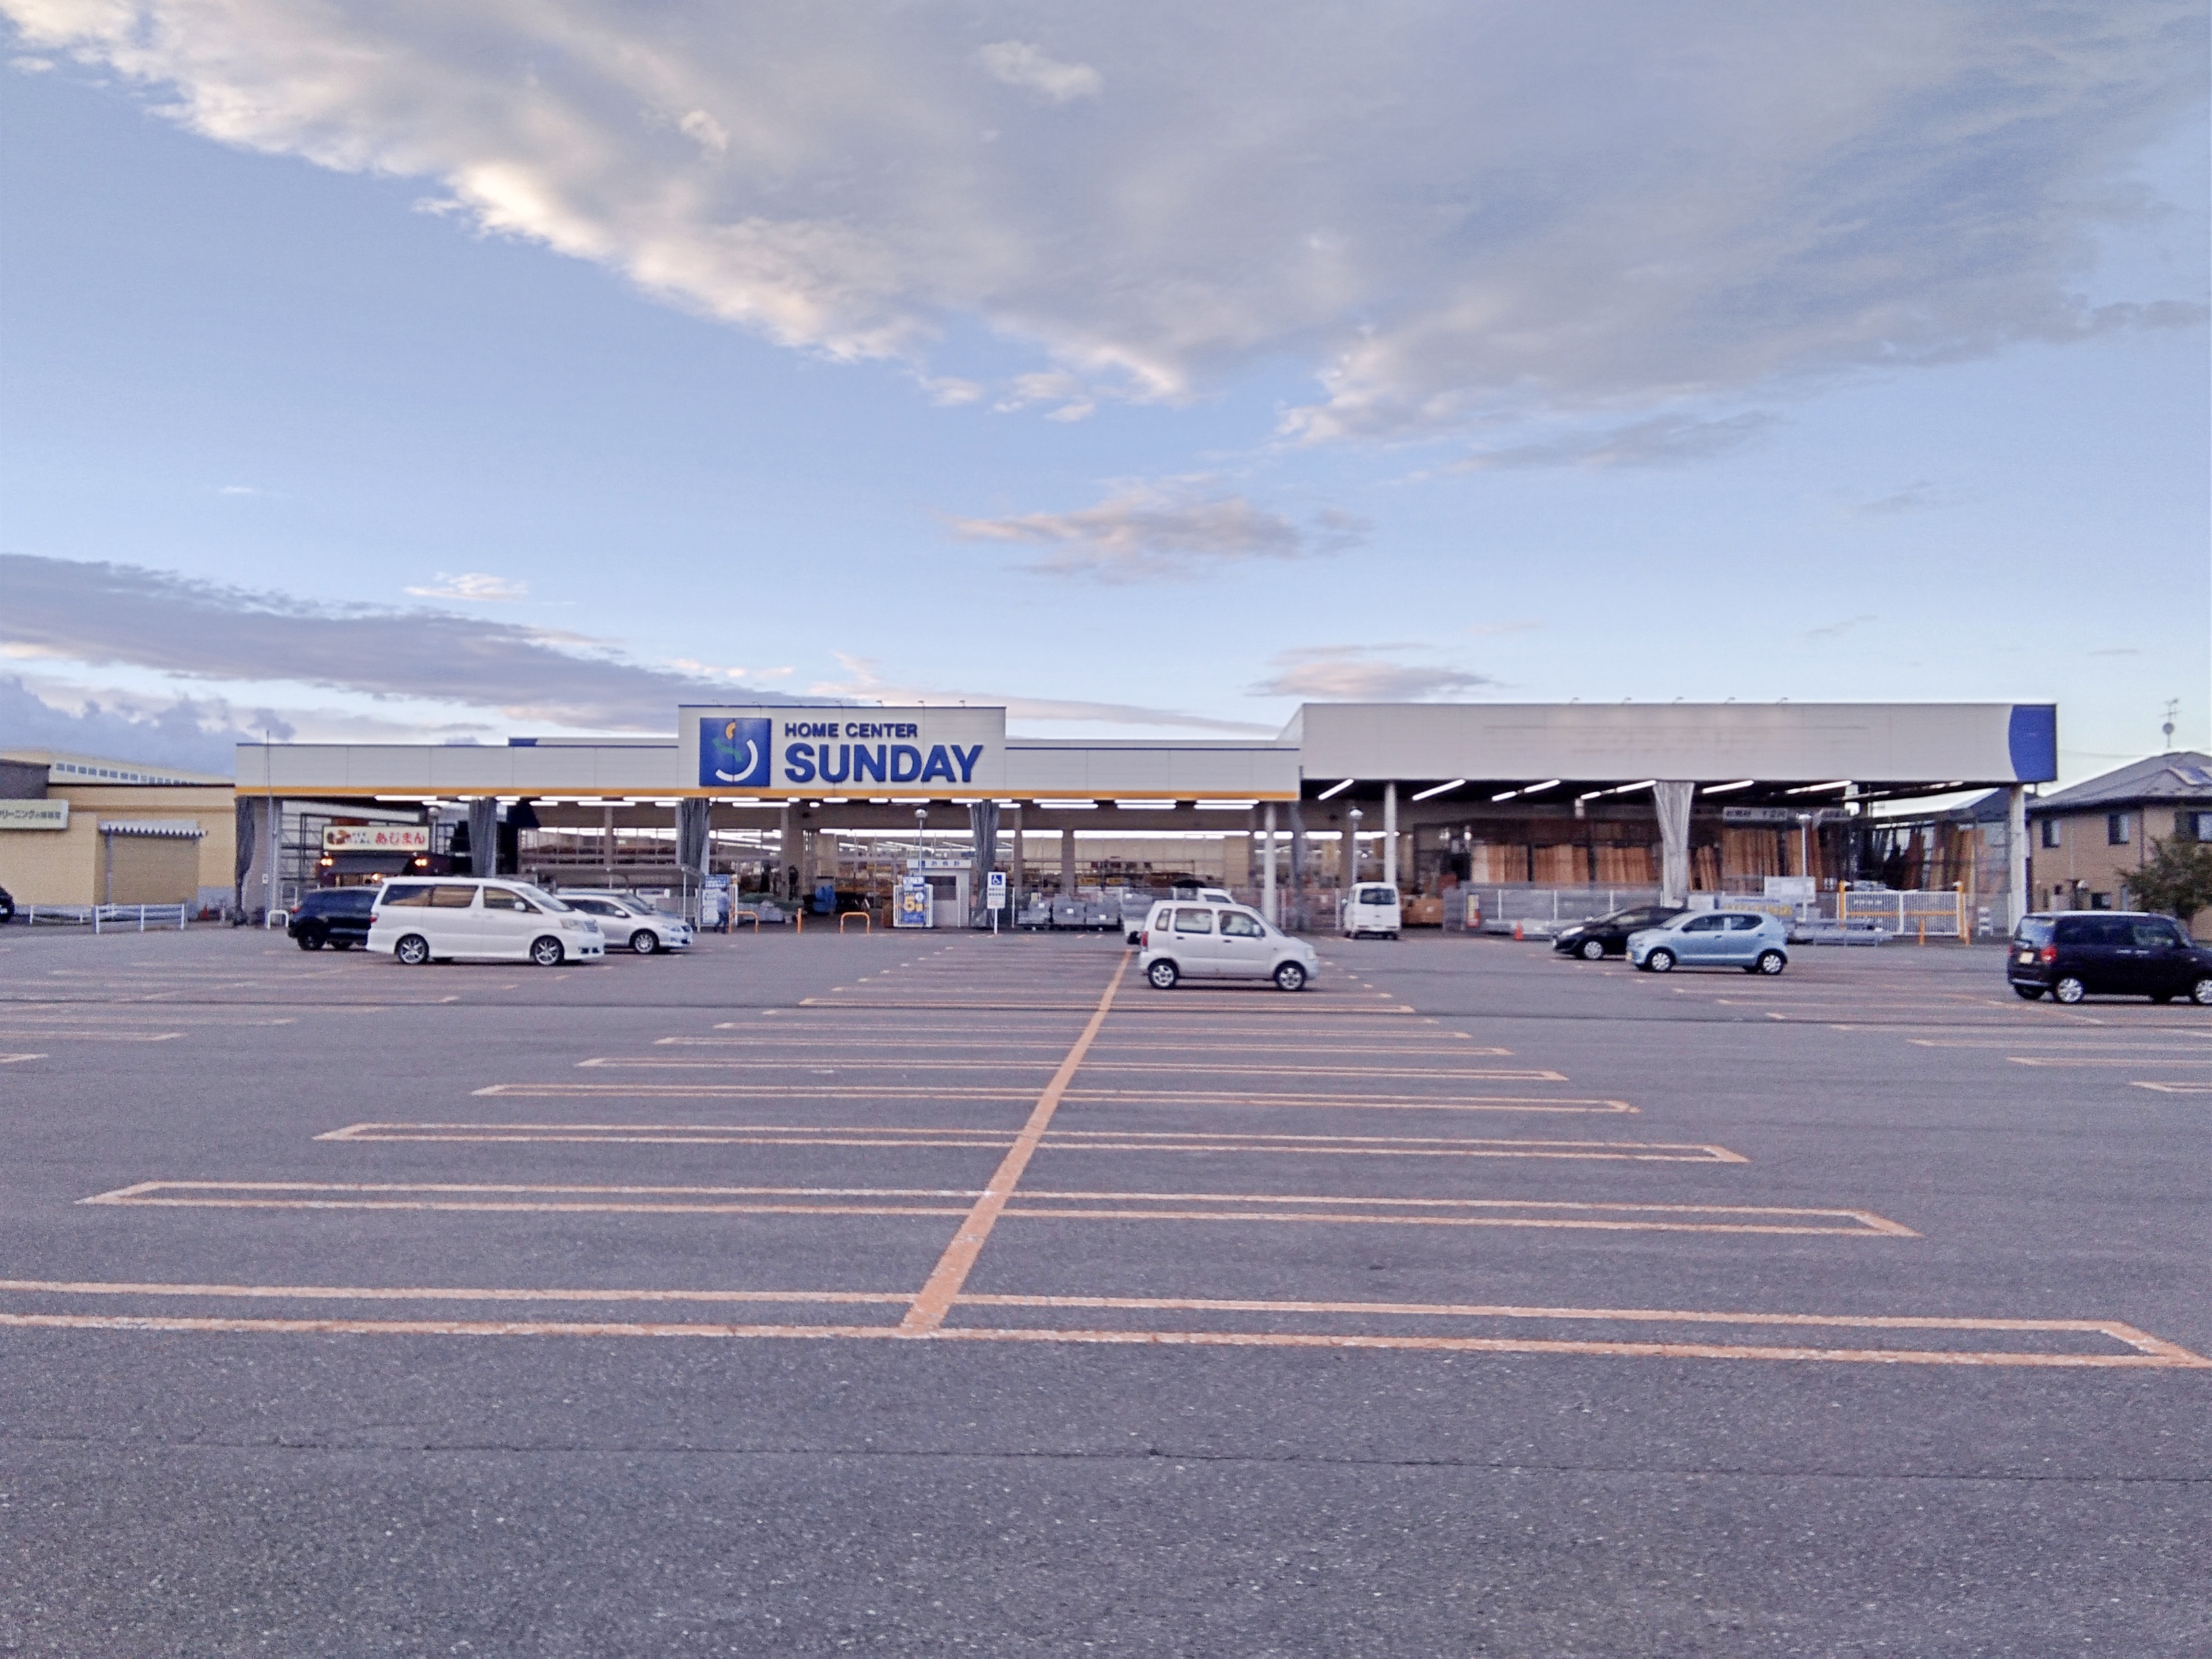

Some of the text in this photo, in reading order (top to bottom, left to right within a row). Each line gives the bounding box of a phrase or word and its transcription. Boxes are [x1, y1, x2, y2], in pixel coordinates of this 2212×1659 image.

[784, 722, 918, 737] HOME CENTER
[784, 742, 984, 783] SUNDAY
[375, 832, 426, 846] あじまん
